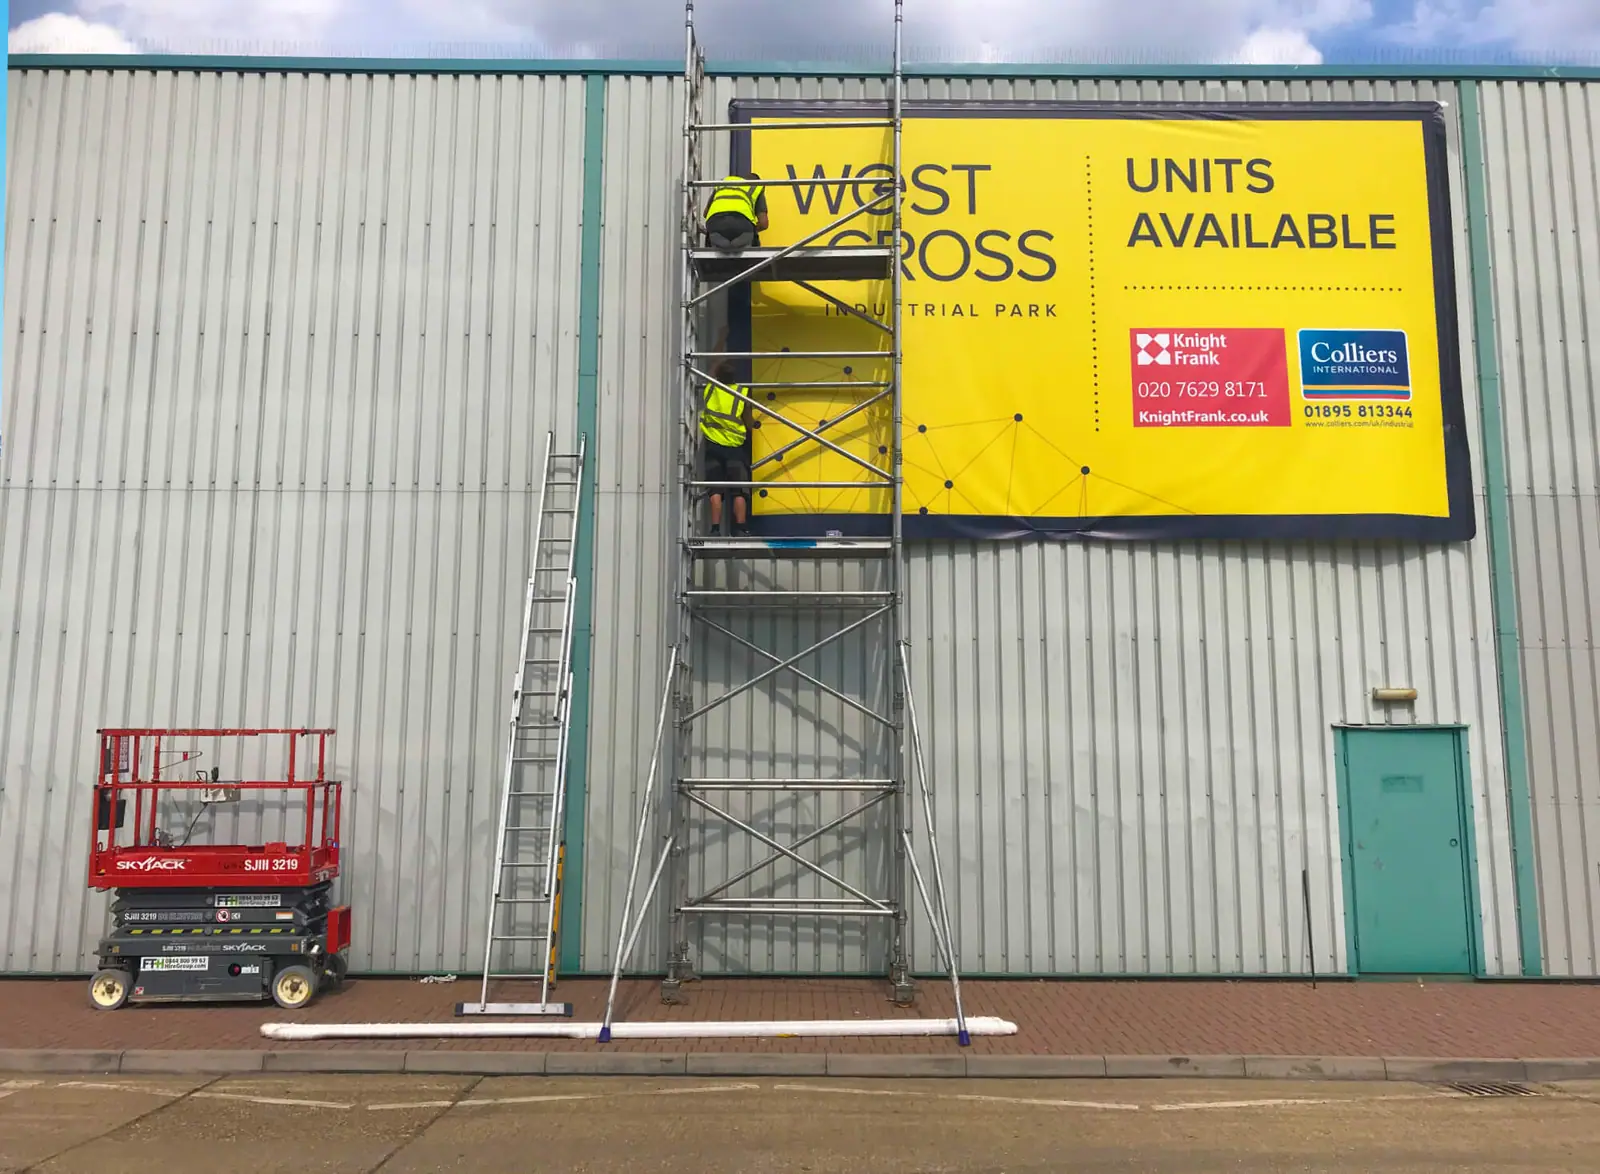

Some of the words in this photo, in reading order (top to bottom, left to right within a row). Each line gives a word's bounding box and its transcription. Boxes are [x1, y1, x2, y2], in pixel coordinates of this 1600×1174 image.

[1126, 158, 1275, 194] UNITS
[1127, 212, 1397, 249] AVAILABLE
[825, 303, 979, 317] INDUTRIAL
[996, 303, 1058, 317] PARK
[1174, 333, 1227, 351] Knight
[1174, 350, 1220, 366] Frank
[1311, 341, 1398, 363] Colliers
[1313, 365, 1399, 374] INTERNATIONAL
[1138, 382, 1171, 397] 020
[1176, 382, 1219, 397] 7629
[1224, 382, 1267, 397] 8171
[1139, 410, 1269, 425] KnightFrank.co.uk
[1304, 405, 1351, 418] 01895
[1358, 405, 1413, 419] 813344
[116, 856, 187, 872] SKYJACK
[272, 858, 298, 871] 3219
[140, 912, 157, 920] 3219
[222, 942, 267, 952] SKYJACK
